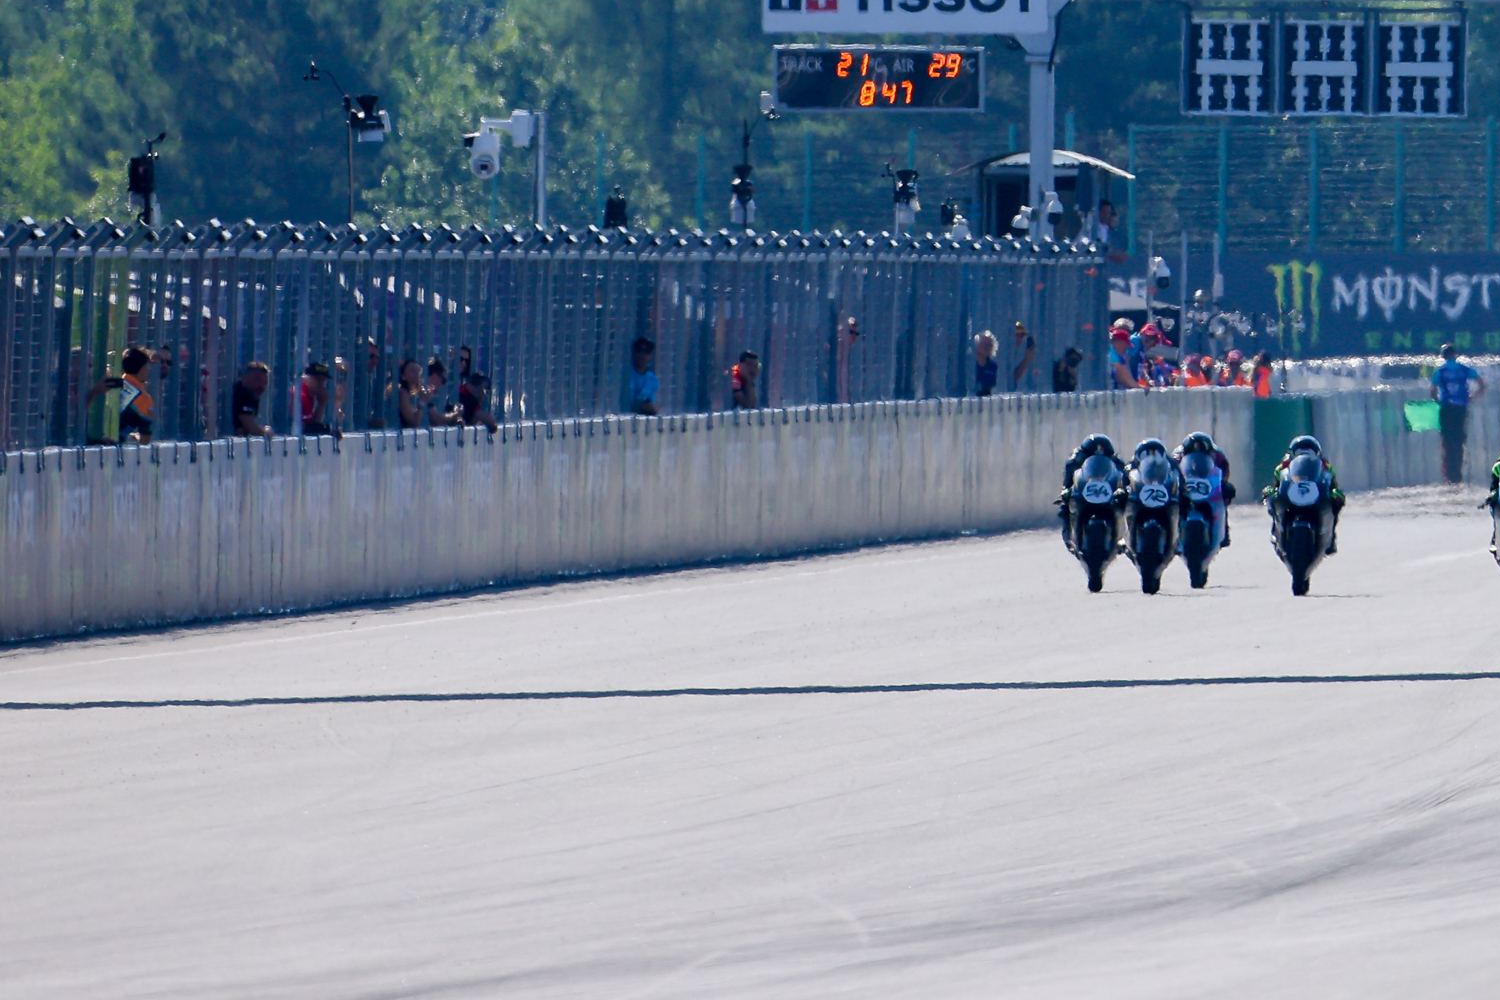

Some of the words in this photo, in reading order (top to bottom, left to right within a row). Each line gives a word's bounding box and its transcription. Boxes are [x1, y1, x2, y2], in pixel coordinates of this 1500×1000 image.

[836, 51, 870, 78] 21
[893, 58, 915, 73] AIR
[928, 52, 962, 78] 29
